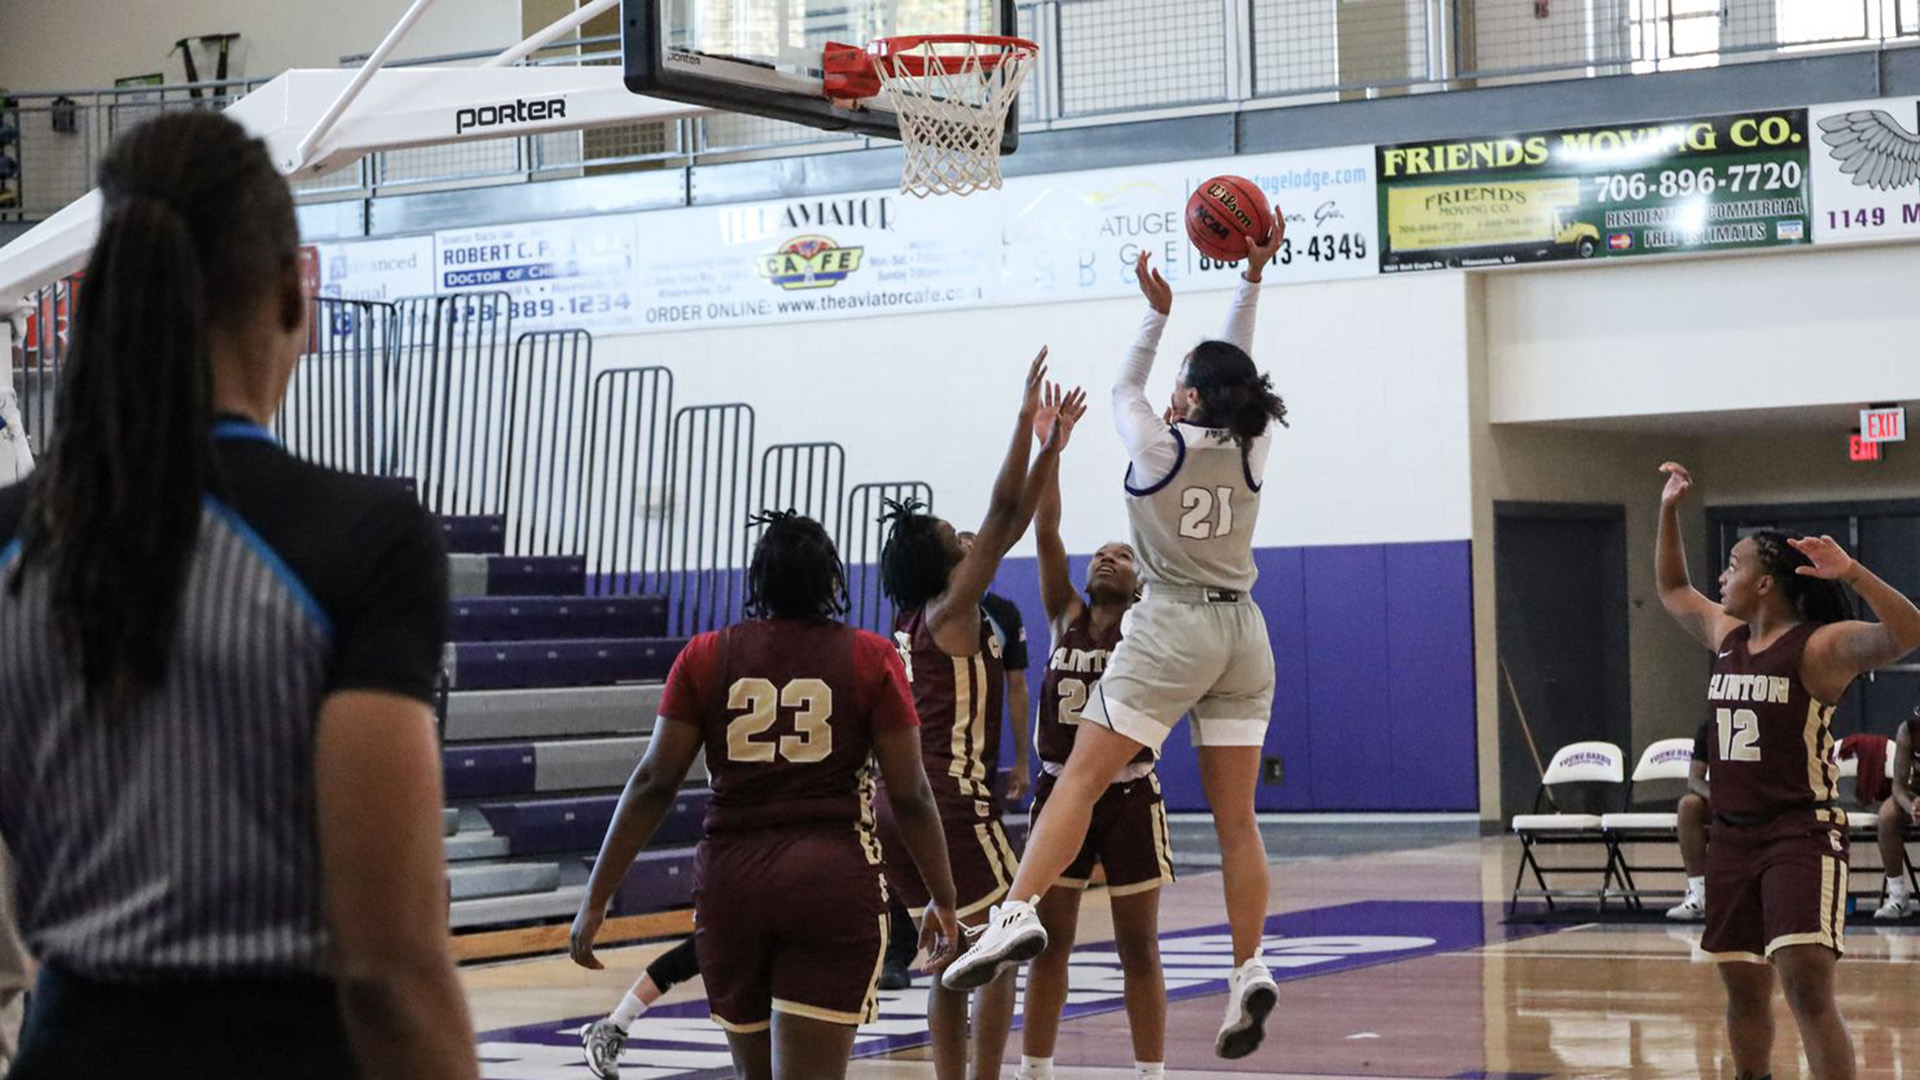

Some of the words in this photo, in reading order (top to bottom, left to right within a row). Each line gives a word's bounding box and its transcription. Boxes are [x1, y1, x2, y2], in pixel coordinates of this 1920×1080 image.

[1384, 137, 1549, 177] FRIENDS
[1562, 122, 1717, 163] MOVG
[1729, 116, 1802, 147] CO.
[1257, 166, 1367, 195] tugelodge.com
[1425, 187, 1527, 210] FRIENDS
[1595, 161, 1801, 203] 706-896-7720
[780, 197, 896, 233] AVIATOR
[1206, 183, 1252, 229] Wilson
[1606, 204, 1692, 228] RESIDEN
[1709, 197, 1804, 221] COMMERCIAL
[1827, 207, 1886, 230] 1149
[444, 243, 512, 266] ROBERT
[517, 242, 534, 259] C.
[766, 251, 852, 275] CAFE
[447, 270, 502, 287] DOCTOR
[506, 267, 524, 280] OF
[646, 304, 702, 324] ORDER
[707, 299, 772, 319] ONLINE:
[777, 286, 983, 315] www.theaviatorcafe.co
[1868, 411, 1899, 438] EXIT
[1178, 485, 1234, 540] 21
[1058, 677, 1099, 725] 2
[727, 677, 832, 763] 23
[1716, 708, 1761, 761] 12
